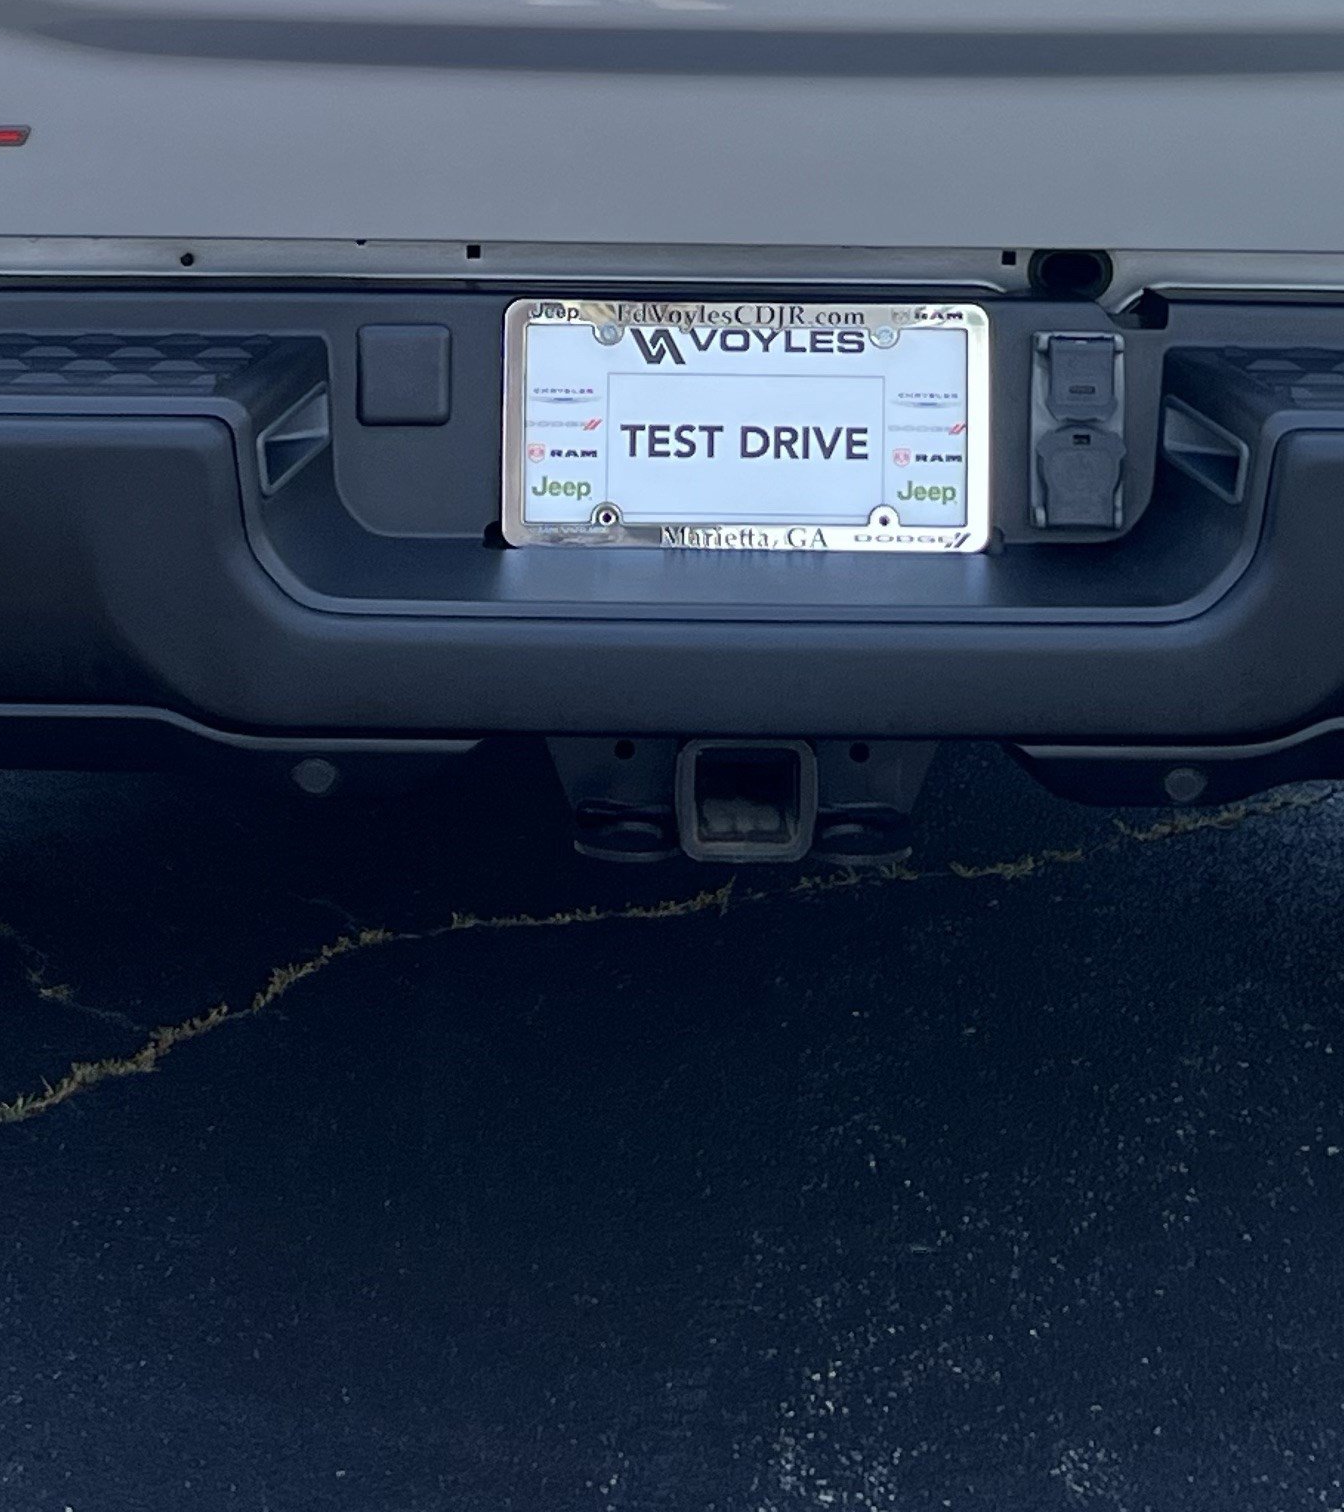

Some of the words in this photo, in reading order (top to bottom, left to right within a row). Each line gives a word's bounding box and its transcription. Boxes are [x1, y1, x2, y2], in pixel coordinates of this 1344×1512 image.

[530, 301, 581, 322] Jeep
[617, 303, 866, 331] EdVoylesCDJR.com
[689, 327, 866, 354] VOYLES
[549, 448, 599, 459] RAM
[619, 423, 725, 459] TEST
[739, 425, 870, 461] DRIVE
[914, 452, 964, 463] RAM
[531, 475, 592, 501] Jeep
[896, 479, 958, 506] Jeep
[659, 525, 778, 550] Marietta,
[787, 526, 830, 549] GA
